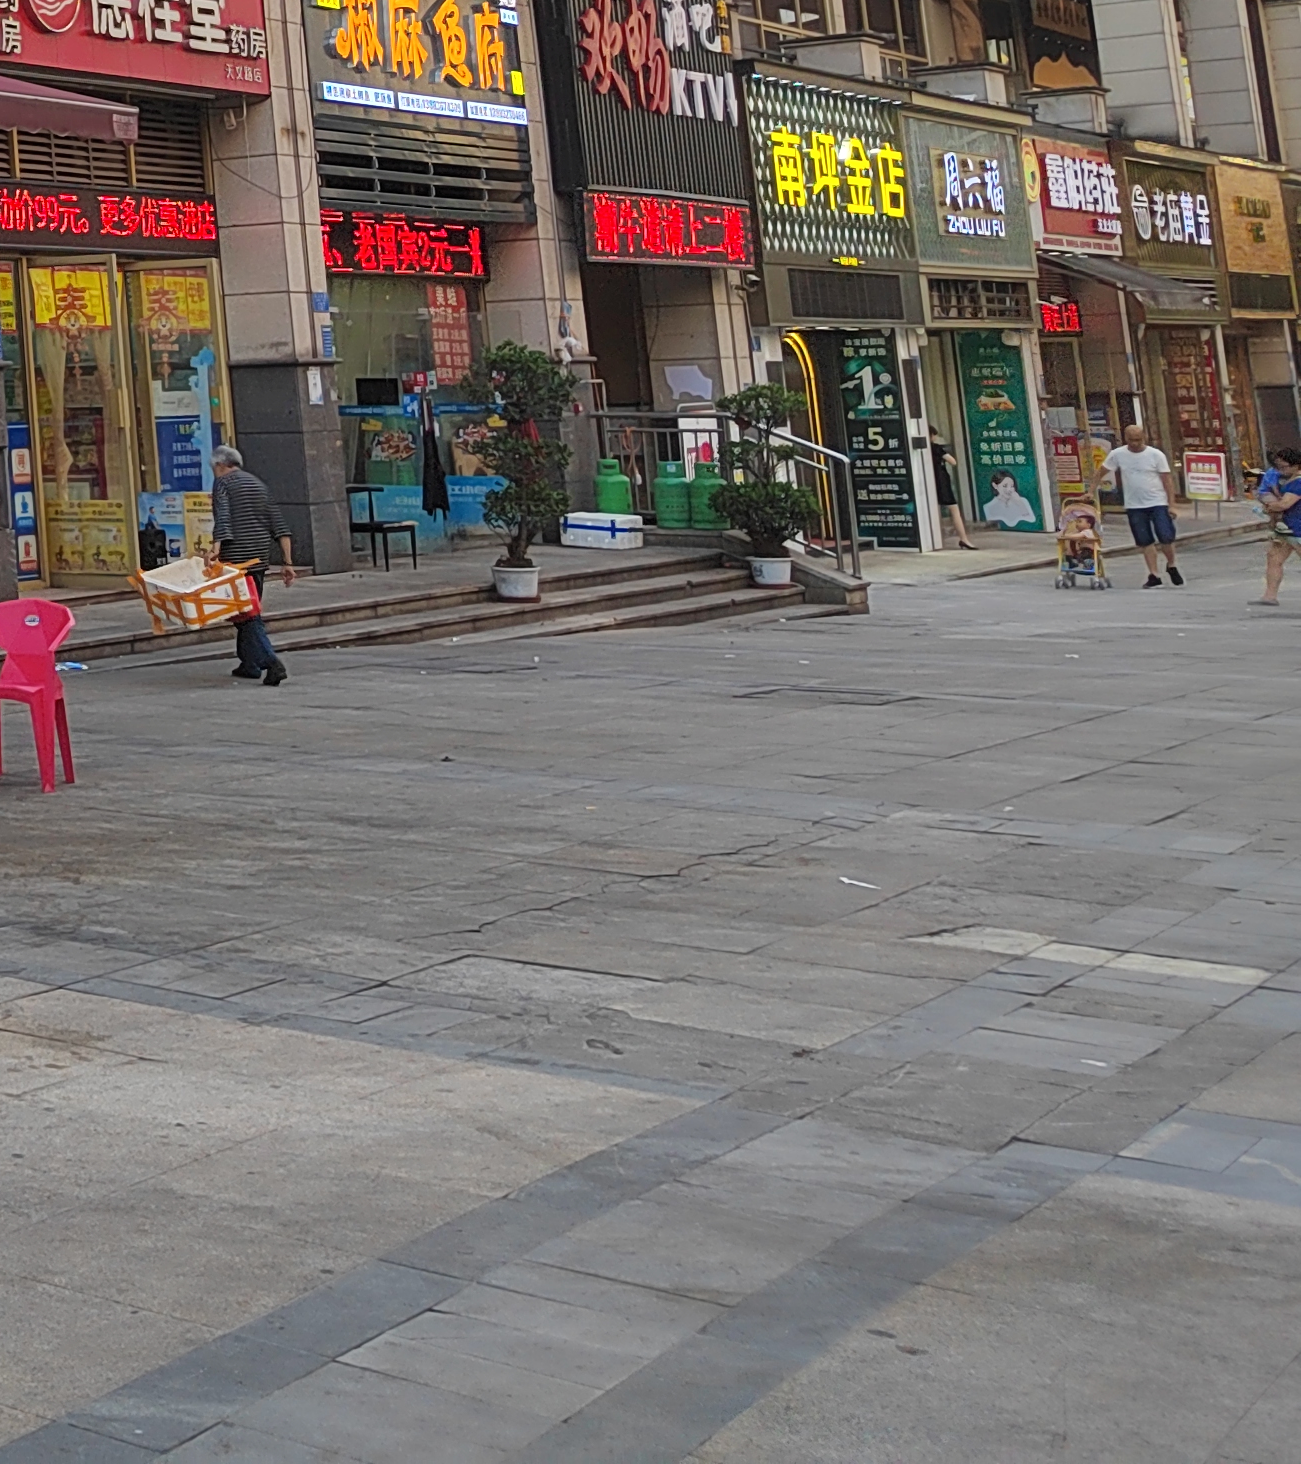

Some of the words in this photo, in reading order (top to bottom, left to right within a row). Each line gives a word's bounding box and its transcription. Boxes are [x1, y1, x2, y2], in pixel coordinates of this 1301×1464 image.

[229, 23, 268, 60] 药房
[671, 67, 724, 122] KTV
[770, 126, 905, 218] 南坪金店
[944, 151, 1006, 216] 周六福
[947, 215, 974, 235] ZHOU
[976, 217, 992, 236] LIU
[993, 218, 1005, 237] FU
[1152, 187, 1213, 246] 老庙黄金
